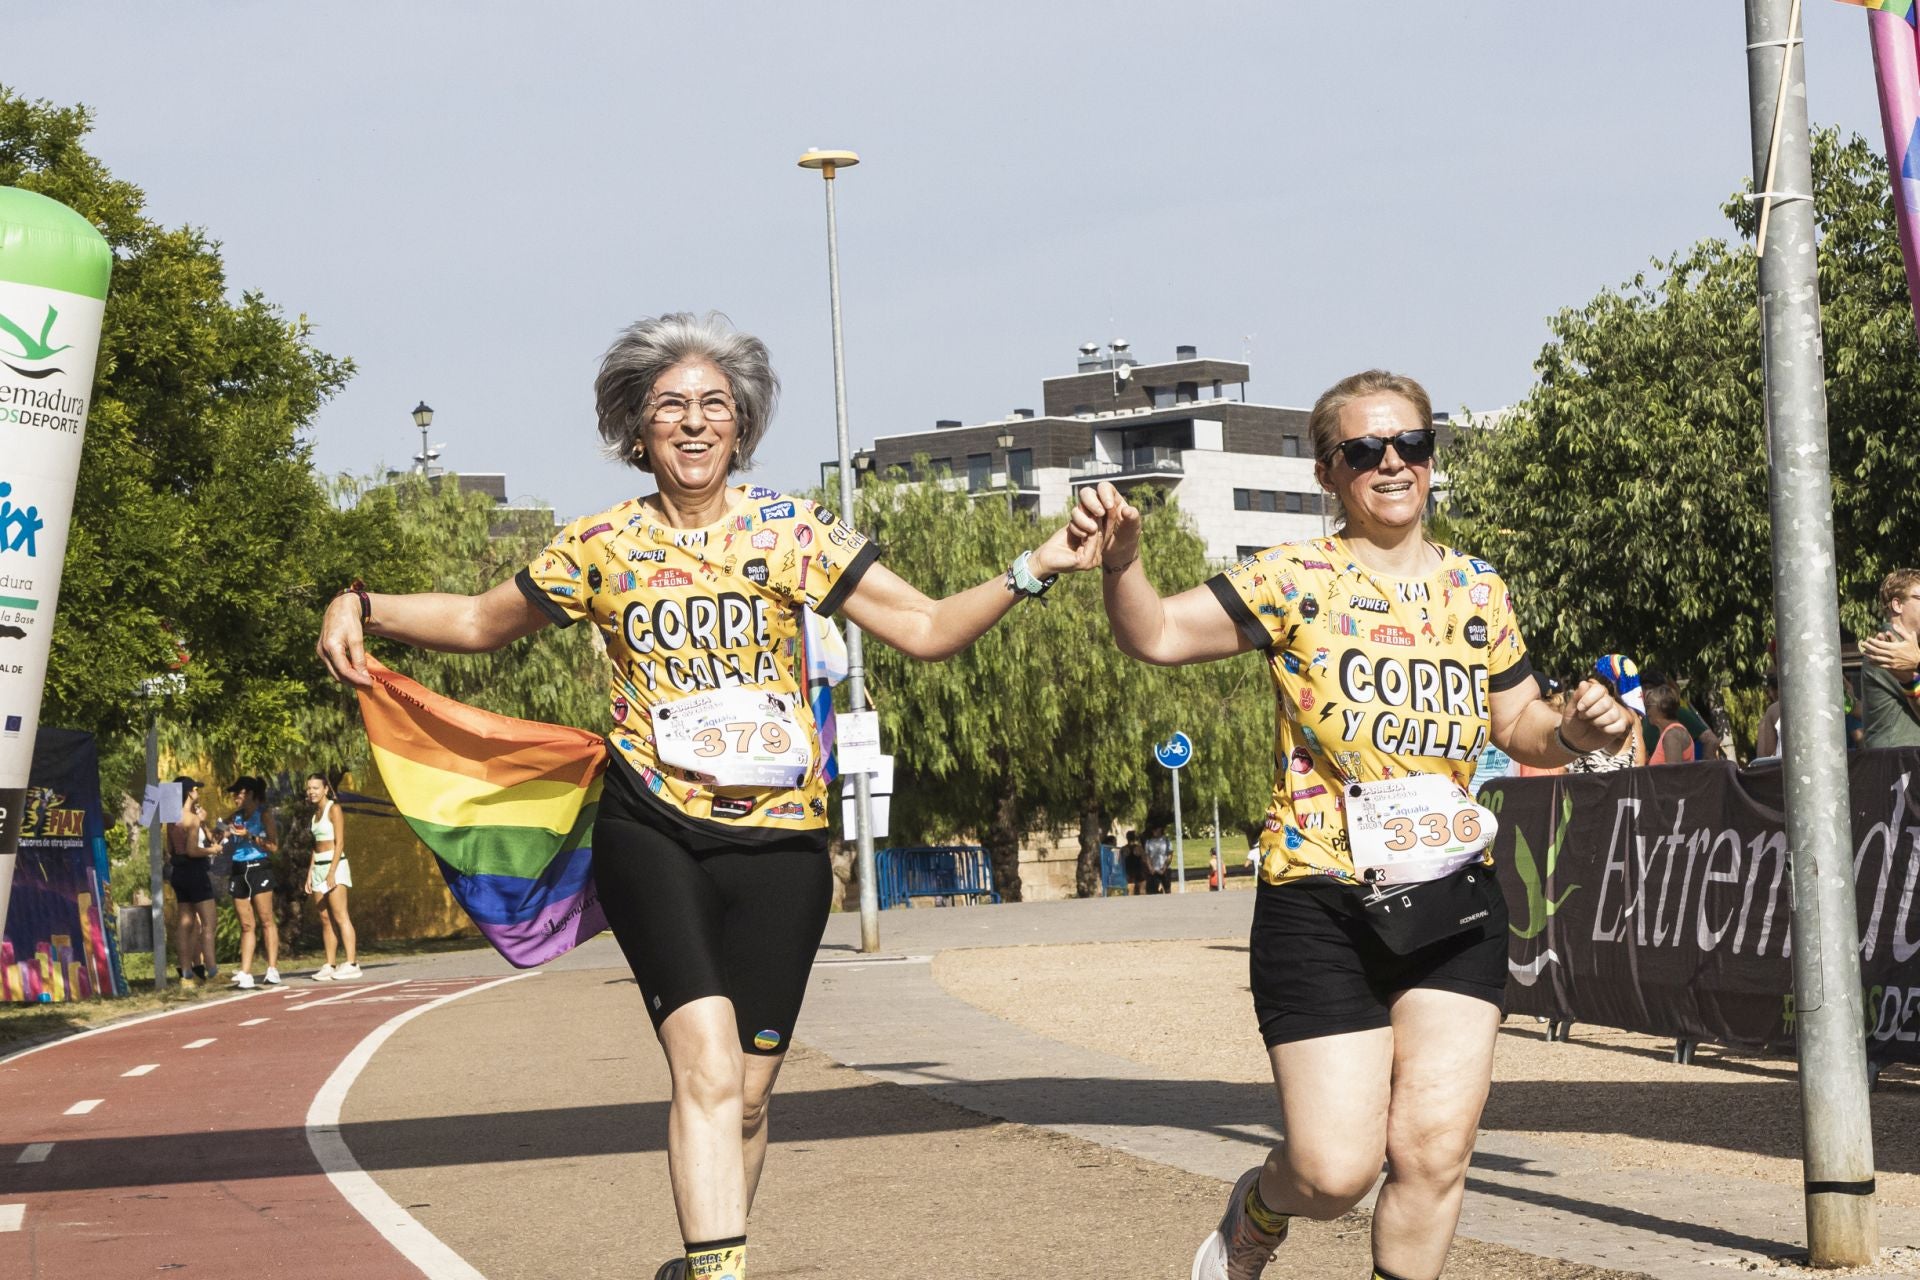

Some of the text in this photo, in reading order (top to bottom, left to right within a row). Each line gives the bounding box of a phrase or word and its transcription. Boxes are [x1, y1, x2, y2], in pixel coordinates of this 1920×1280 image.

[674, 531, 708, 548] KM
[628, 549, 666, 563] POWER
[609, 570, 636, 594] RUN
[651, 577, 689, 587] STRONG
[663, 569, 675, 578] BE
[1396, 582, 1430, 603] KM
[1350, 594, 1390, 614] POWER
[1, 611, 35, 624] la Base
[623, 592, 770, 654] CORRE
[1329, 611, 1358, 637] RUN
[1373, 635, 1411, 646] STRONG
[1385, 627, 1398, 636] BE
[12, 665, 23, 674] DE
[638, 660, 657, 691] Y
[1339, 648, 1489, 721] CORRE
[692, 722, 791, 758] 379
[1342, 709, 1366, 742] Y
[1371, 711, 1487, 763] CALLA
[49, 809, 85, 836] FLAX
[1383, 808, 1482, 851] 336
[18, 837, 84, 850] Sabores de otra galaxia
